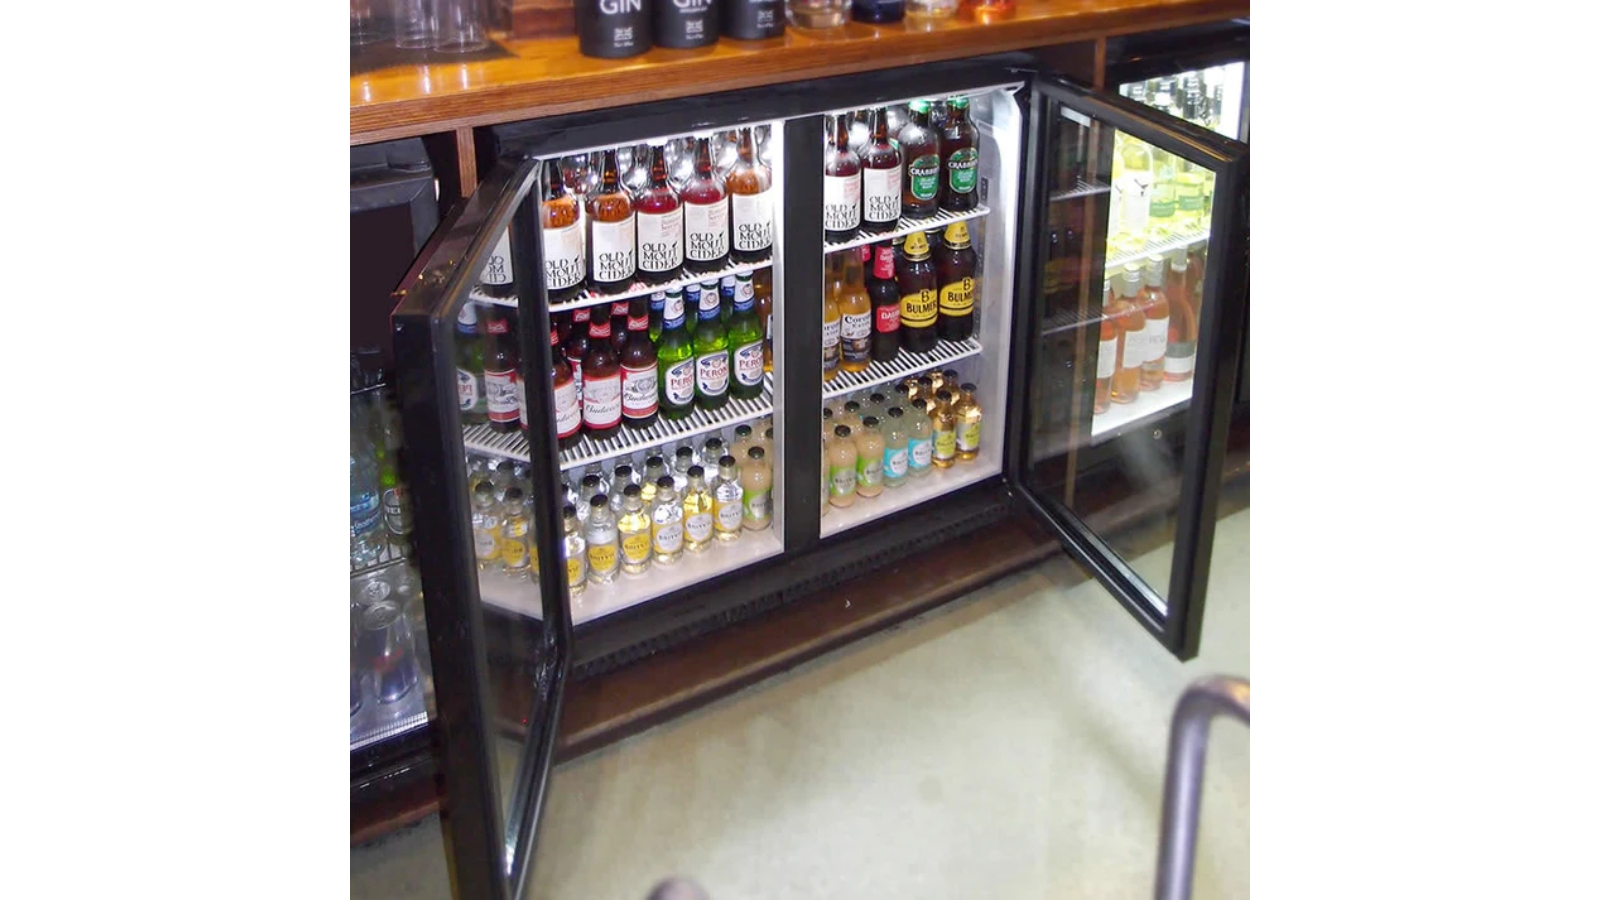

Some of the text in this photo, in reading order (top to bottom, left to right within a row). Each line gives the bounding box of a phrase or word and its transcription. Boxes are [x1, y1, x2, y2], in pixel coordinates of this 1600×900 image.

[600, 0, 642, 15] GIN
[739, 223, 762, 233] OLD
[690, 232, 714, 242] OLD
[642, 243, 667, 252] OLD
[599, 252, 625, 262] OLD
[642, 259, 678, 270] CIDER
[700, 366, 727, 378] PERON
